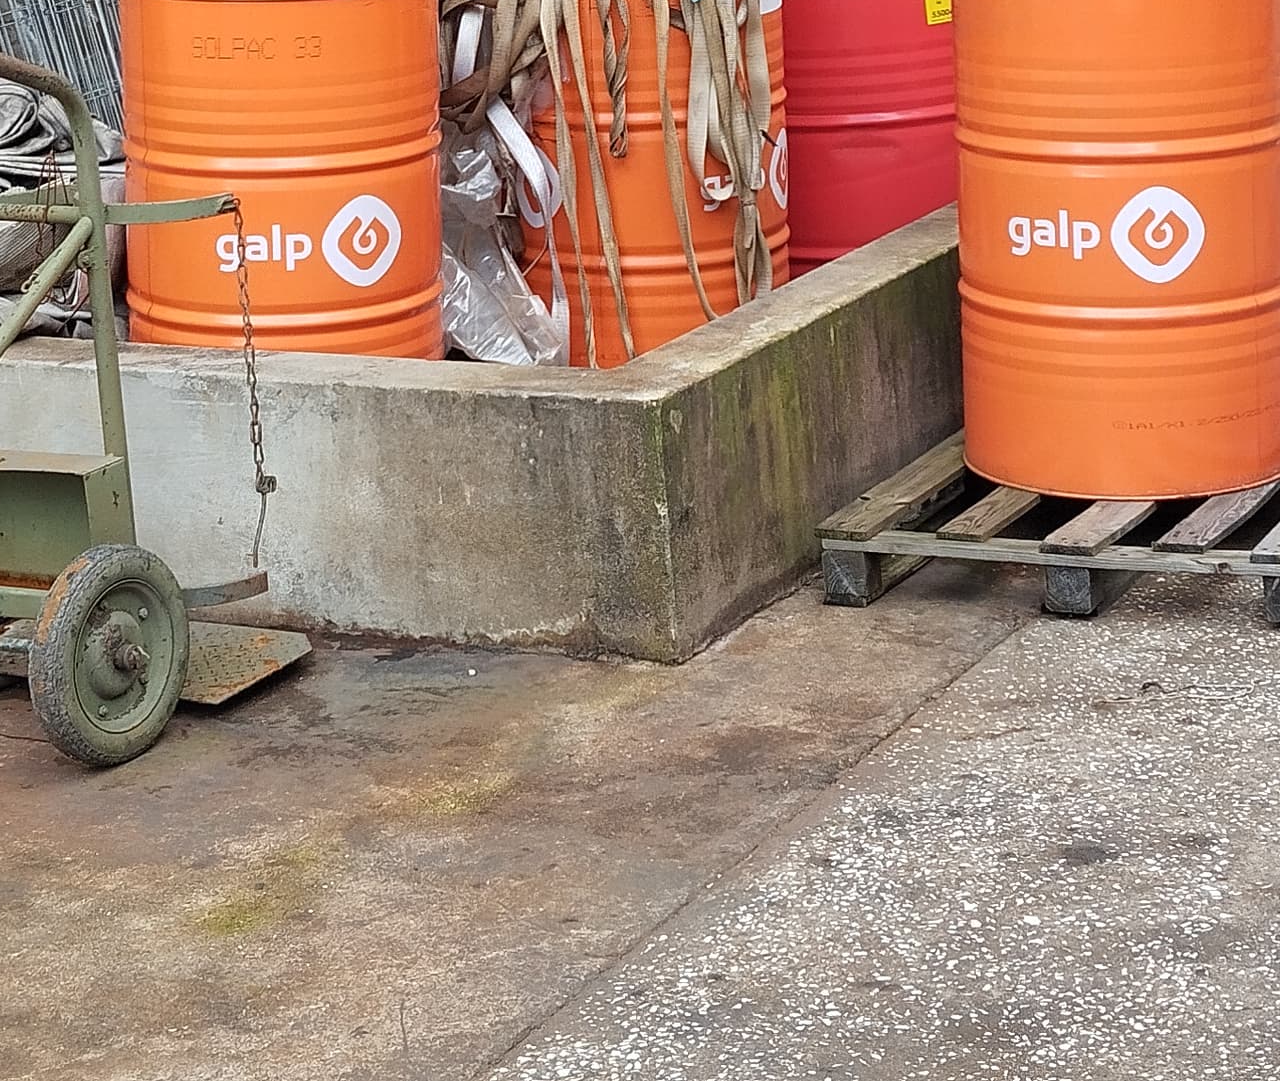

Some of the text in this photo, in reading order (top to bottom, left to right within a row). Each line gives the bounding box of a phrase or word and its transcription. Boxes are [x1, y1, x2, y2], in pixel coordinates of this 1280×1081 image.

[192, 35, 322, 60] SOLPAC 33
[215, 223, 313, 272] galp
[1008, 209, 1101, 260] galp
